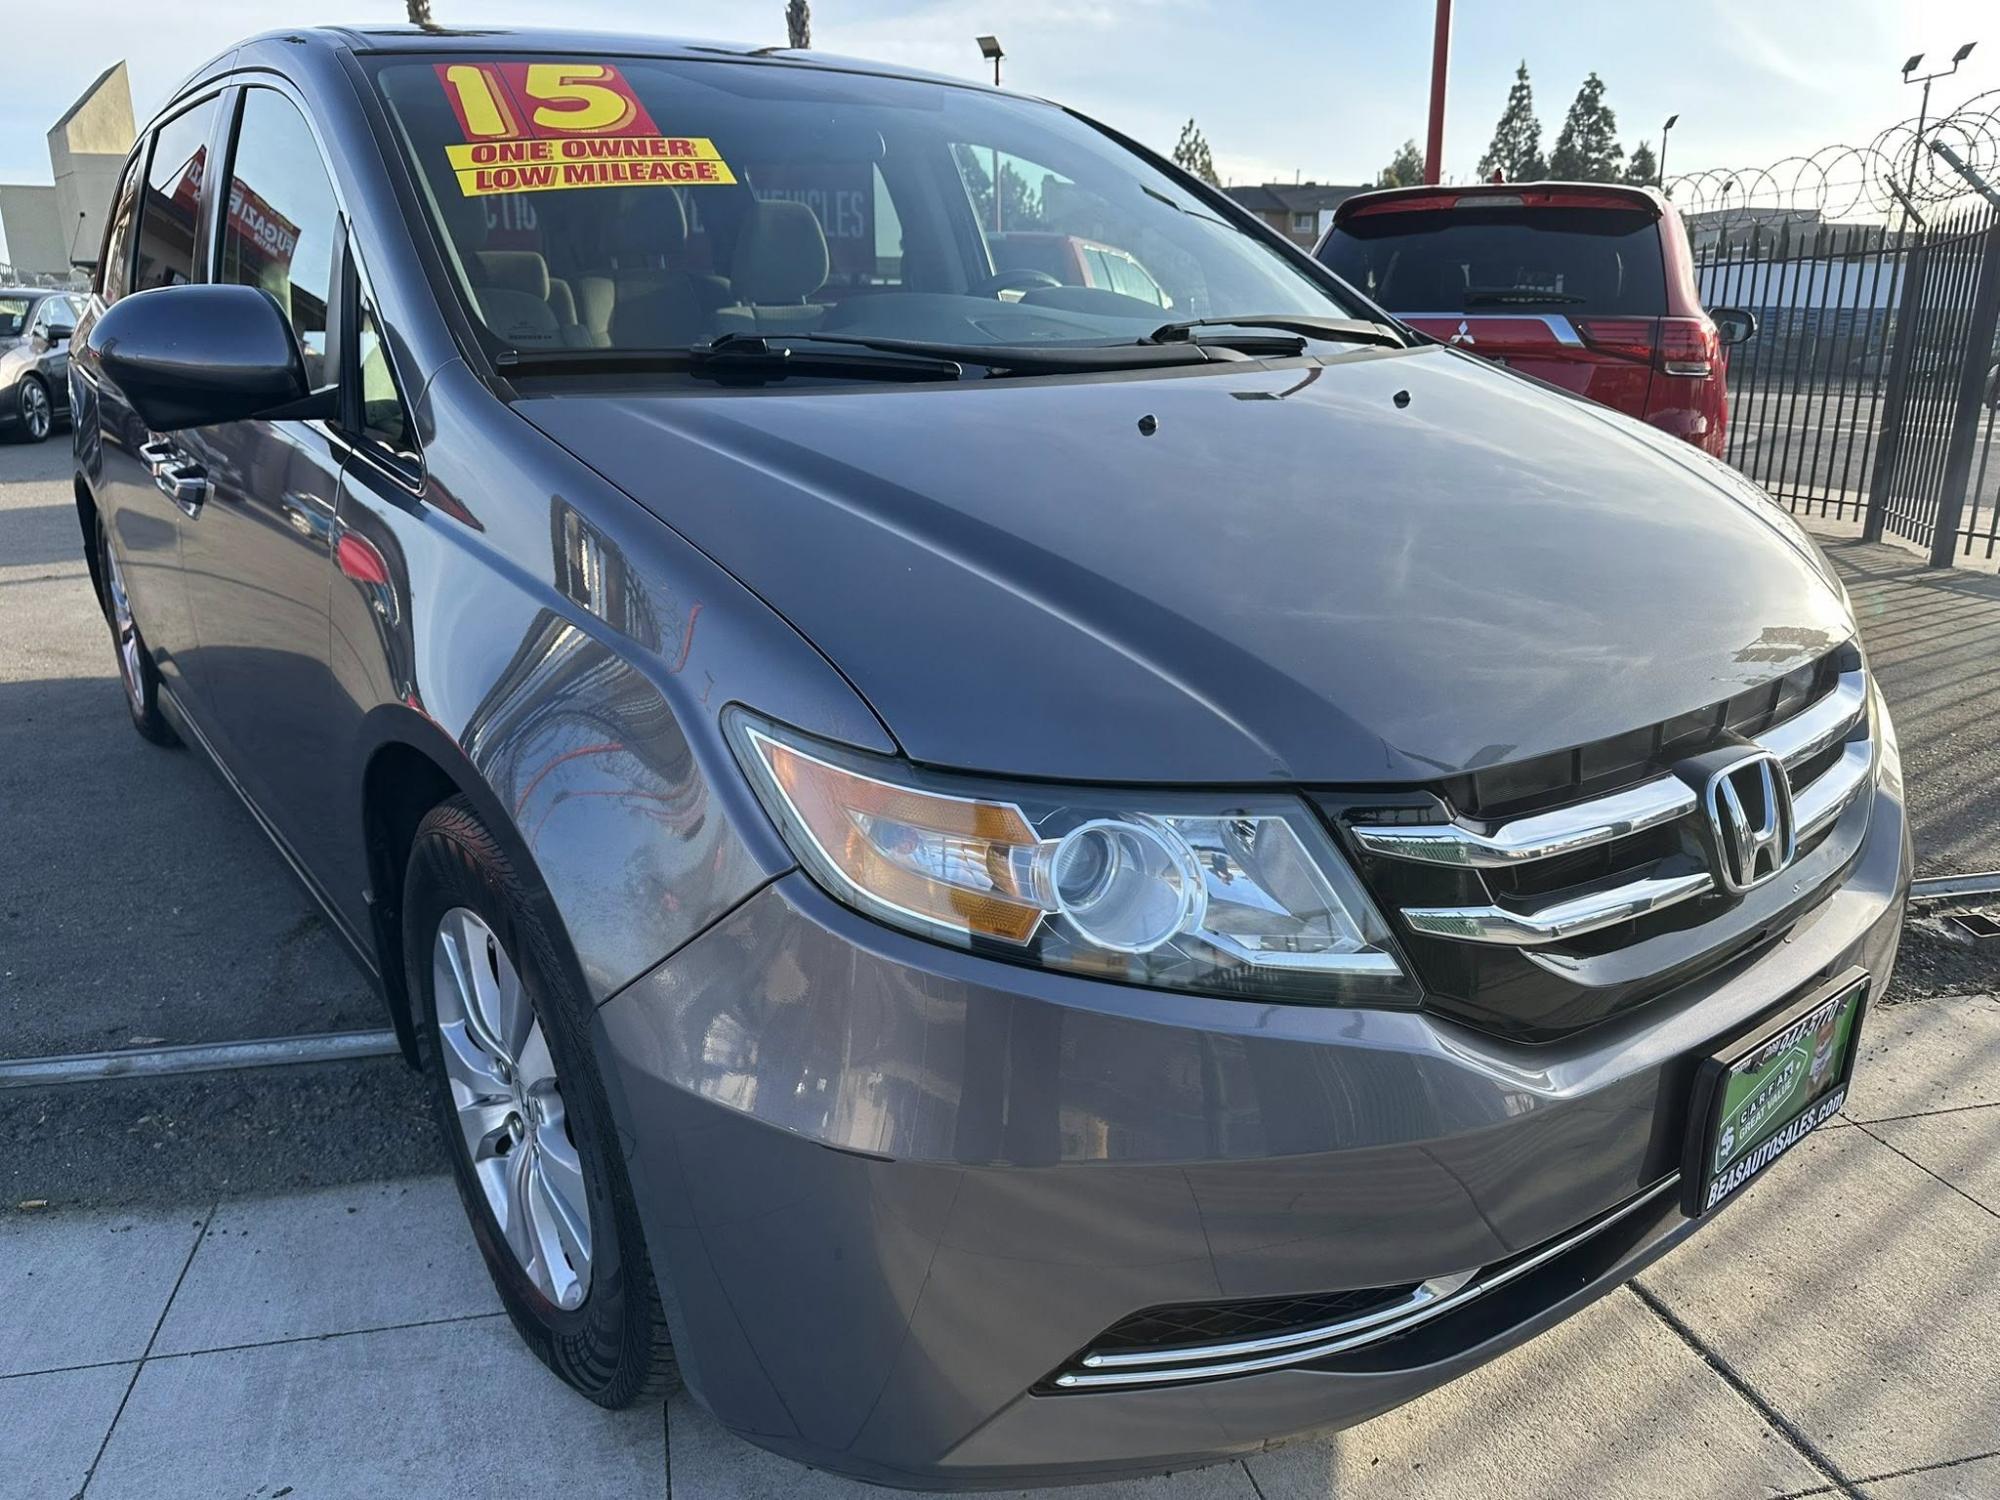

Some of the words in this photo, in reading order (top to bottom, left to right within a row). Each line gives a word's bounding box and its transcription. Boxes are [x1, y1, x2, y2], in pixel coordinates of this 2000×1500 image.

[446, 63, 635, 137] 15
[471, 142, 551, 165] ONE
[561, 139, 697, 162] OWNER
[476, 165, 557, 192] LOW
[563, 162, 718, 186] MILEAGE
[1739, 1105, 1766, 1140] GREAT
[1767, 1079, 1793, 1110] VALUE
[1706, 1090, 1845, 1211] BEASAUTOSALES.com
